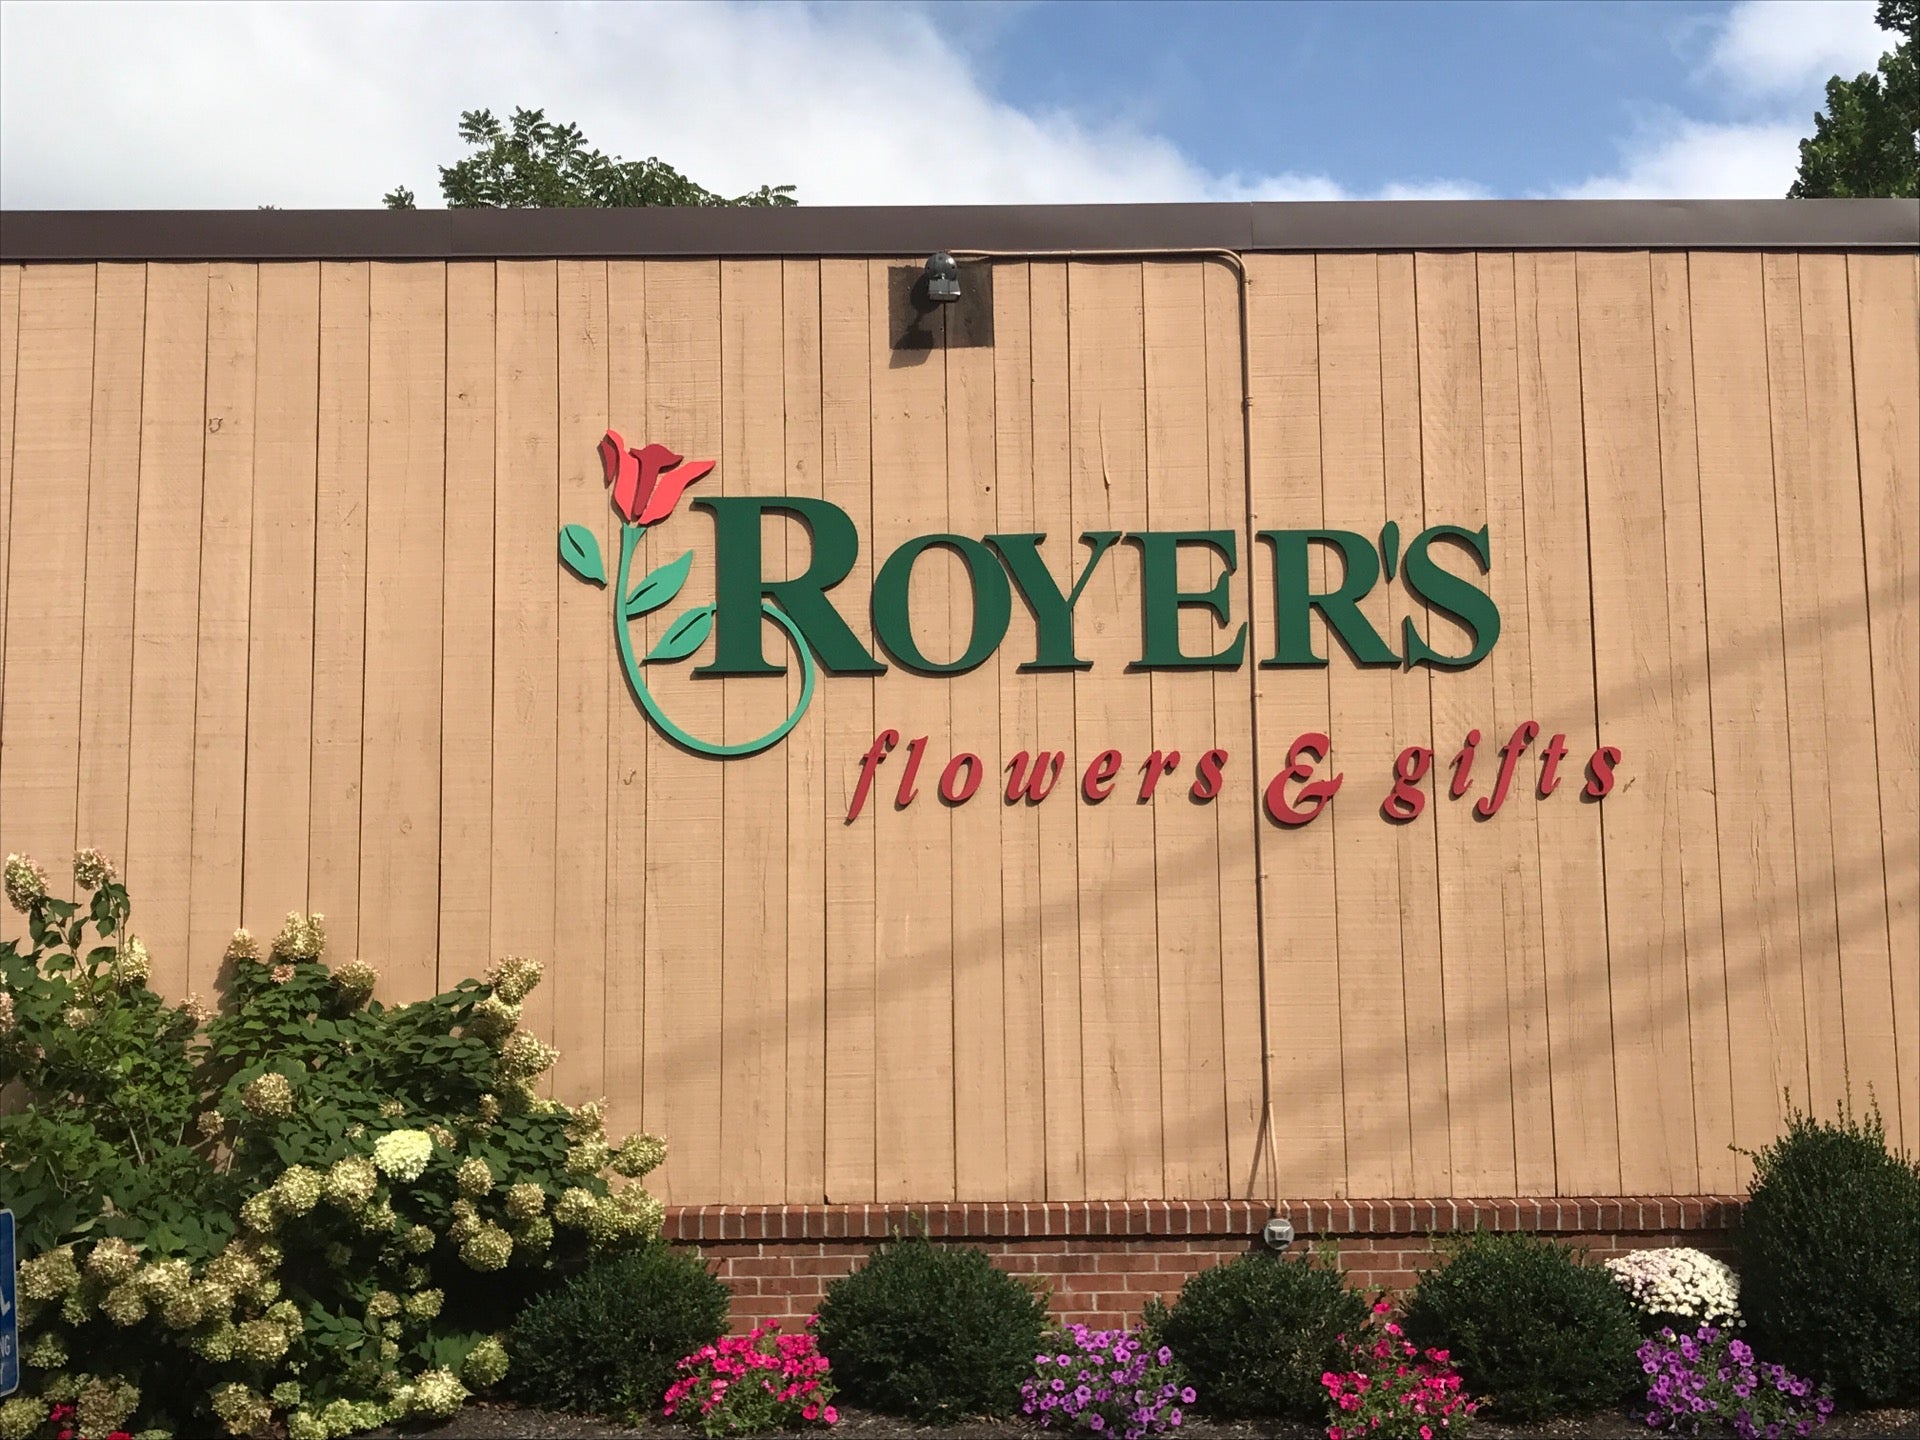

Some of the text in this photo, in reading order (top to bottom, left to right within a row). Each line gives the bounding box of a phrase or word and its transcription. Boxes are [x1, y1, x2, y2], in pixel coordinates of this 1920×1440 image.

[692, 495, 1501, 674] ROYER'S
[845, 720, 1624, 828] flowers & gifts
